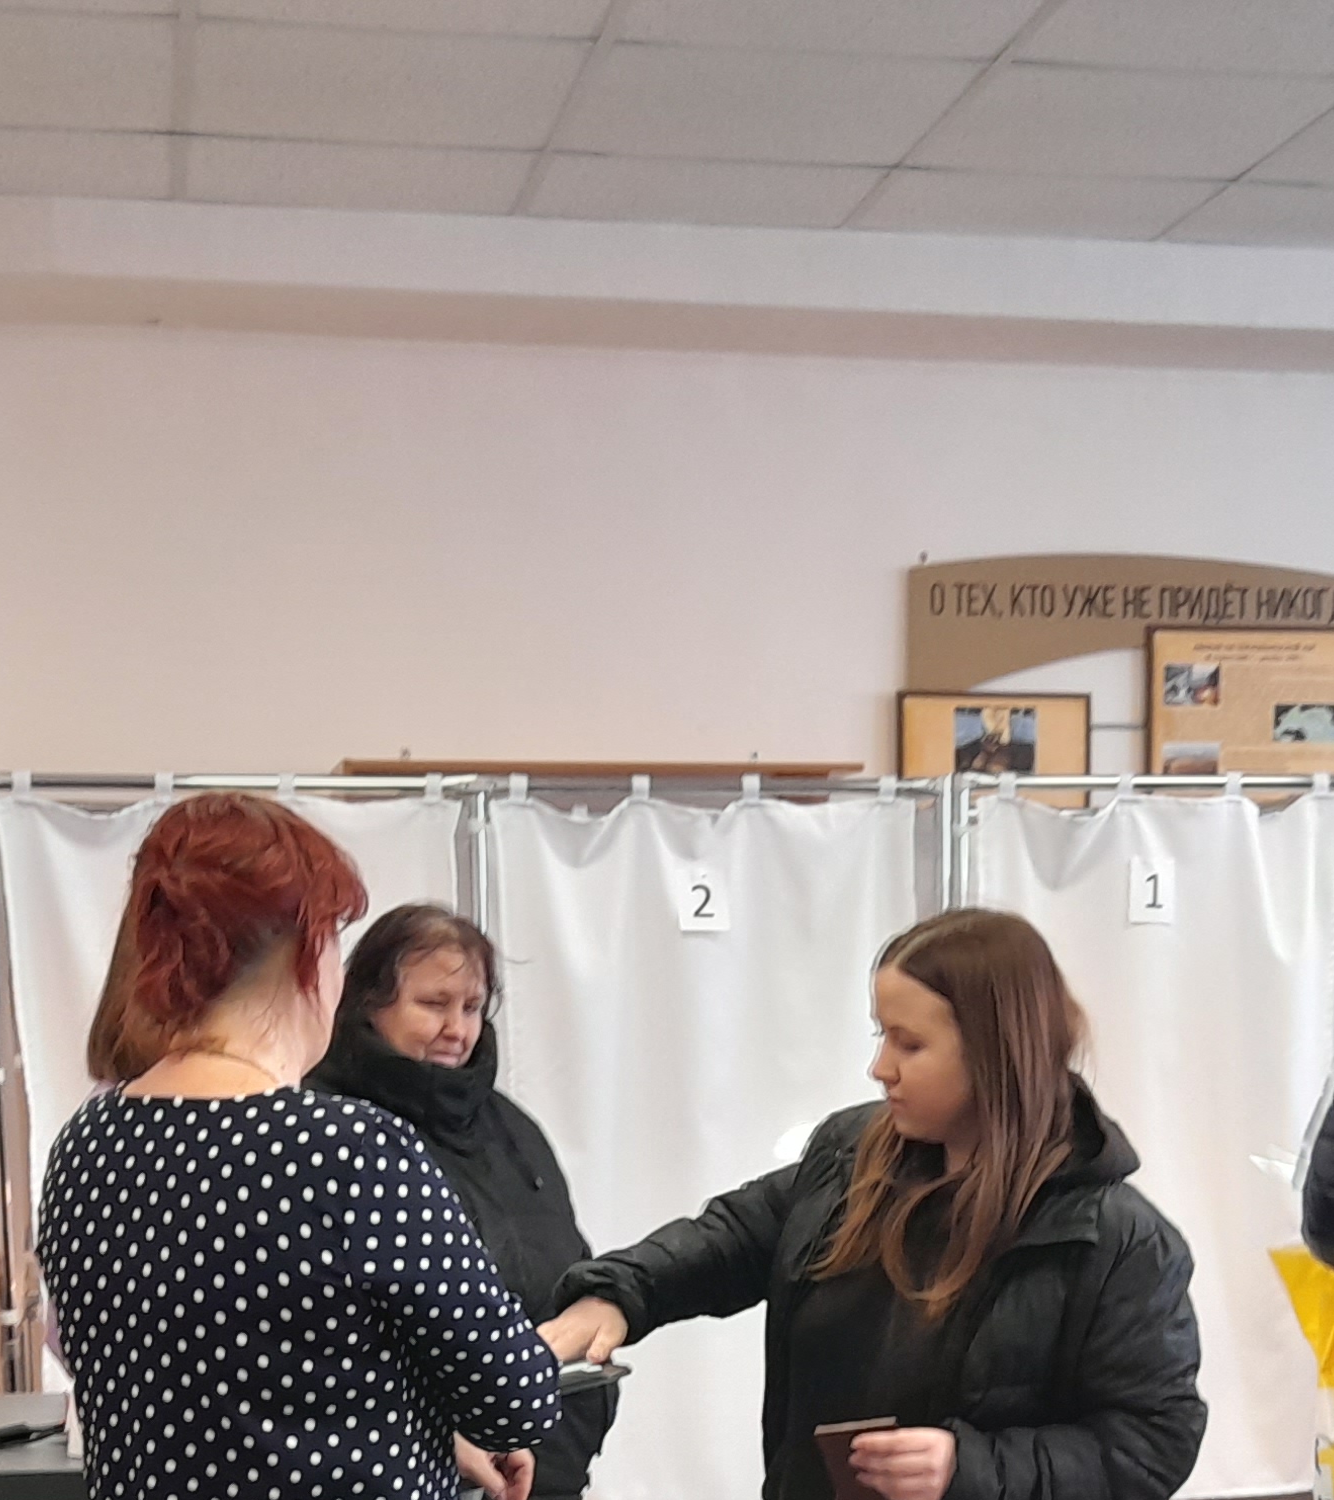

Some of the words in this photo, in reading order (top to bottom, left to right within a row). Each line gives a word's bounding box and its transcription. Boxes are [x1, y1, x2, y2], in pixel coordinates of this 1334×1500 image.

[930, 581, 946, 617] О
[953, 582, 1004, 618] ТЕХ,
[1010, 583, 1055, 618] КТО
[1062, 583, 1116, 619] УЖЕ
[1122, 584, 1152, 619] НЕ
[1157, 583, 1250, 624] ПРИДЁТ
[692, 884, 715, 918] 2
[1144, 874, 1165, 910] 1
